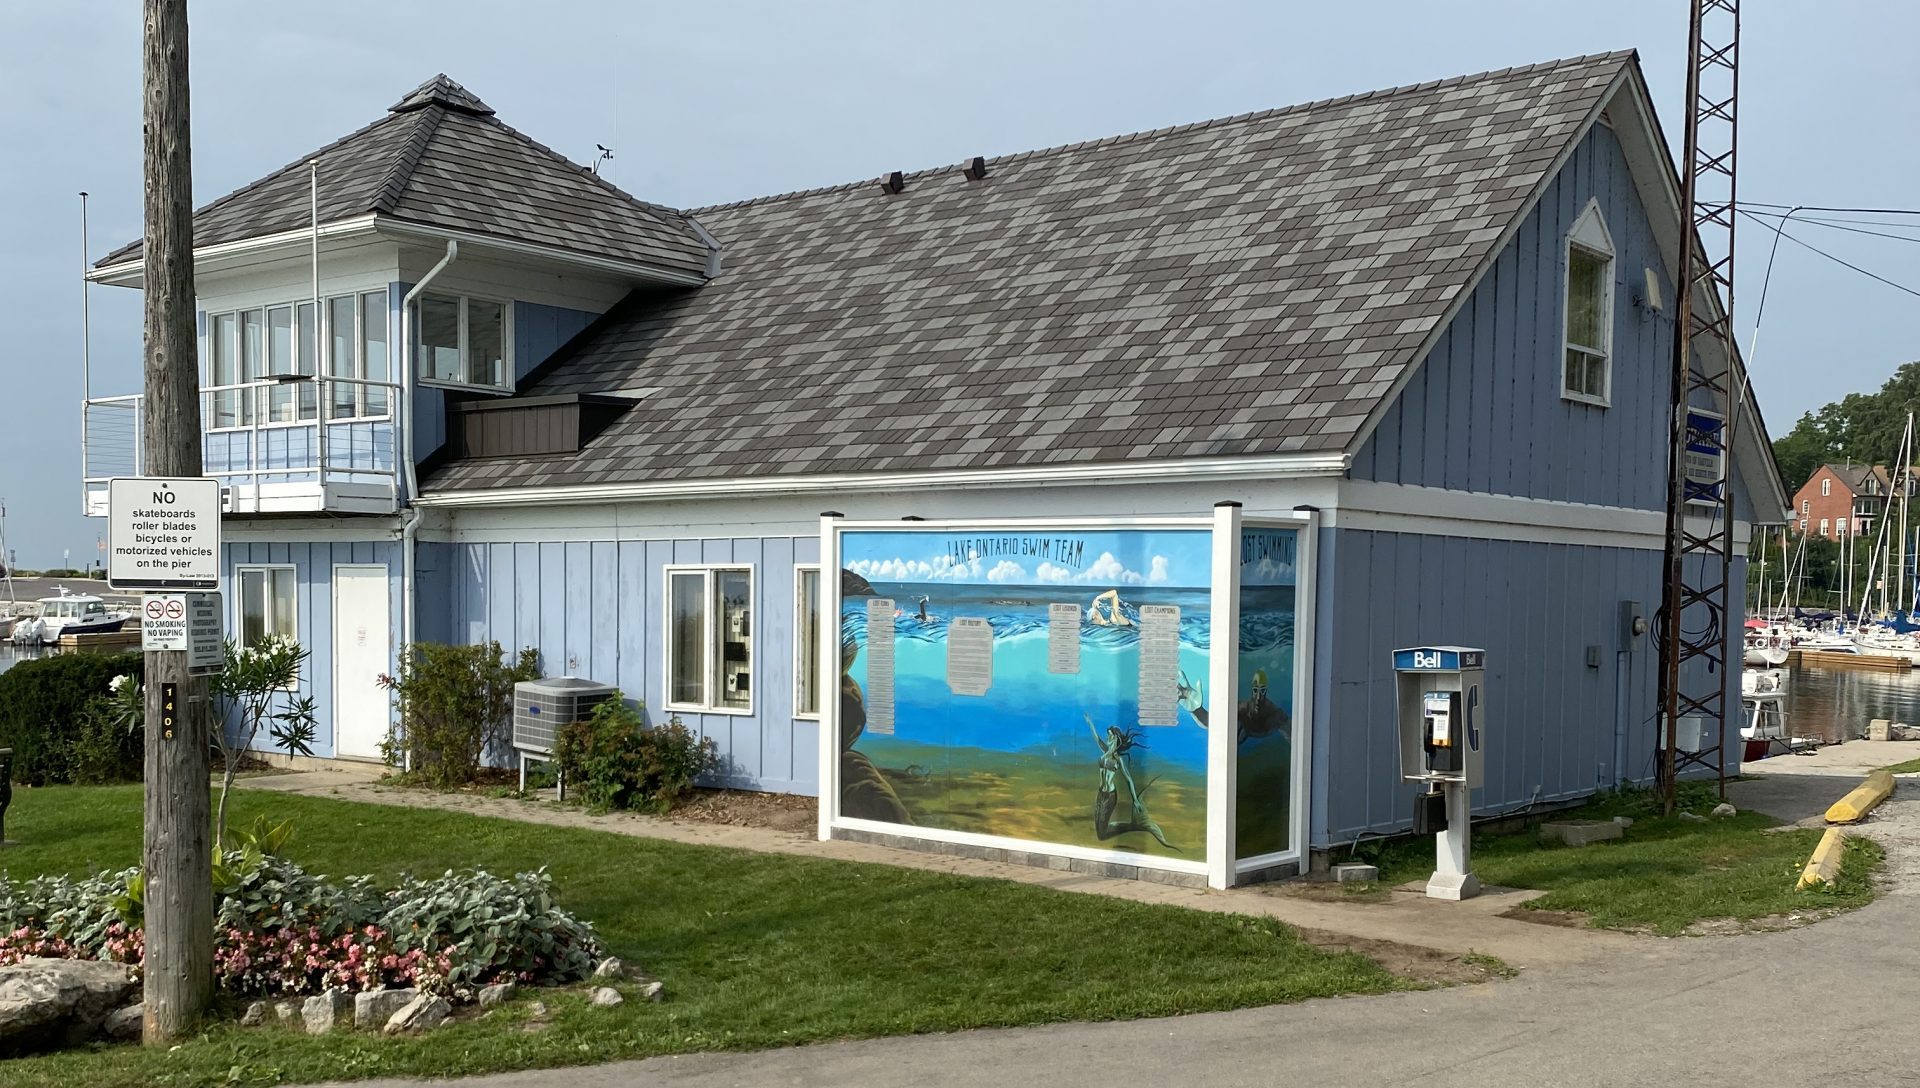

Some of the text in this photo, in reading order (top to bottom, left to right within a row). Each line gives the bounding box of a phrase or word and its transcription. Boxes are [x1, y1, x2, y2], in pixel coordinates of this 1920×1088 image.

[153, 492, 176, 504] NO
[132, 509, 196, 518] skateboards
[132, 521, 197, 531] roller blades
[136, 534, 192, 544] bicycles or
[116, 546, 213, 556] motorized vehicles
[948, 538, 1084, 569] LAKE ONTARIO SWIM TEAM
[136, 559, 191, 570] on the pier
[144, 620, 186, 628] NO SMOKING
[147, 629, 158, 637] NO
[1414, 651, 1441, 668] Bell
[1466, 654, 1476, 665] Bell
